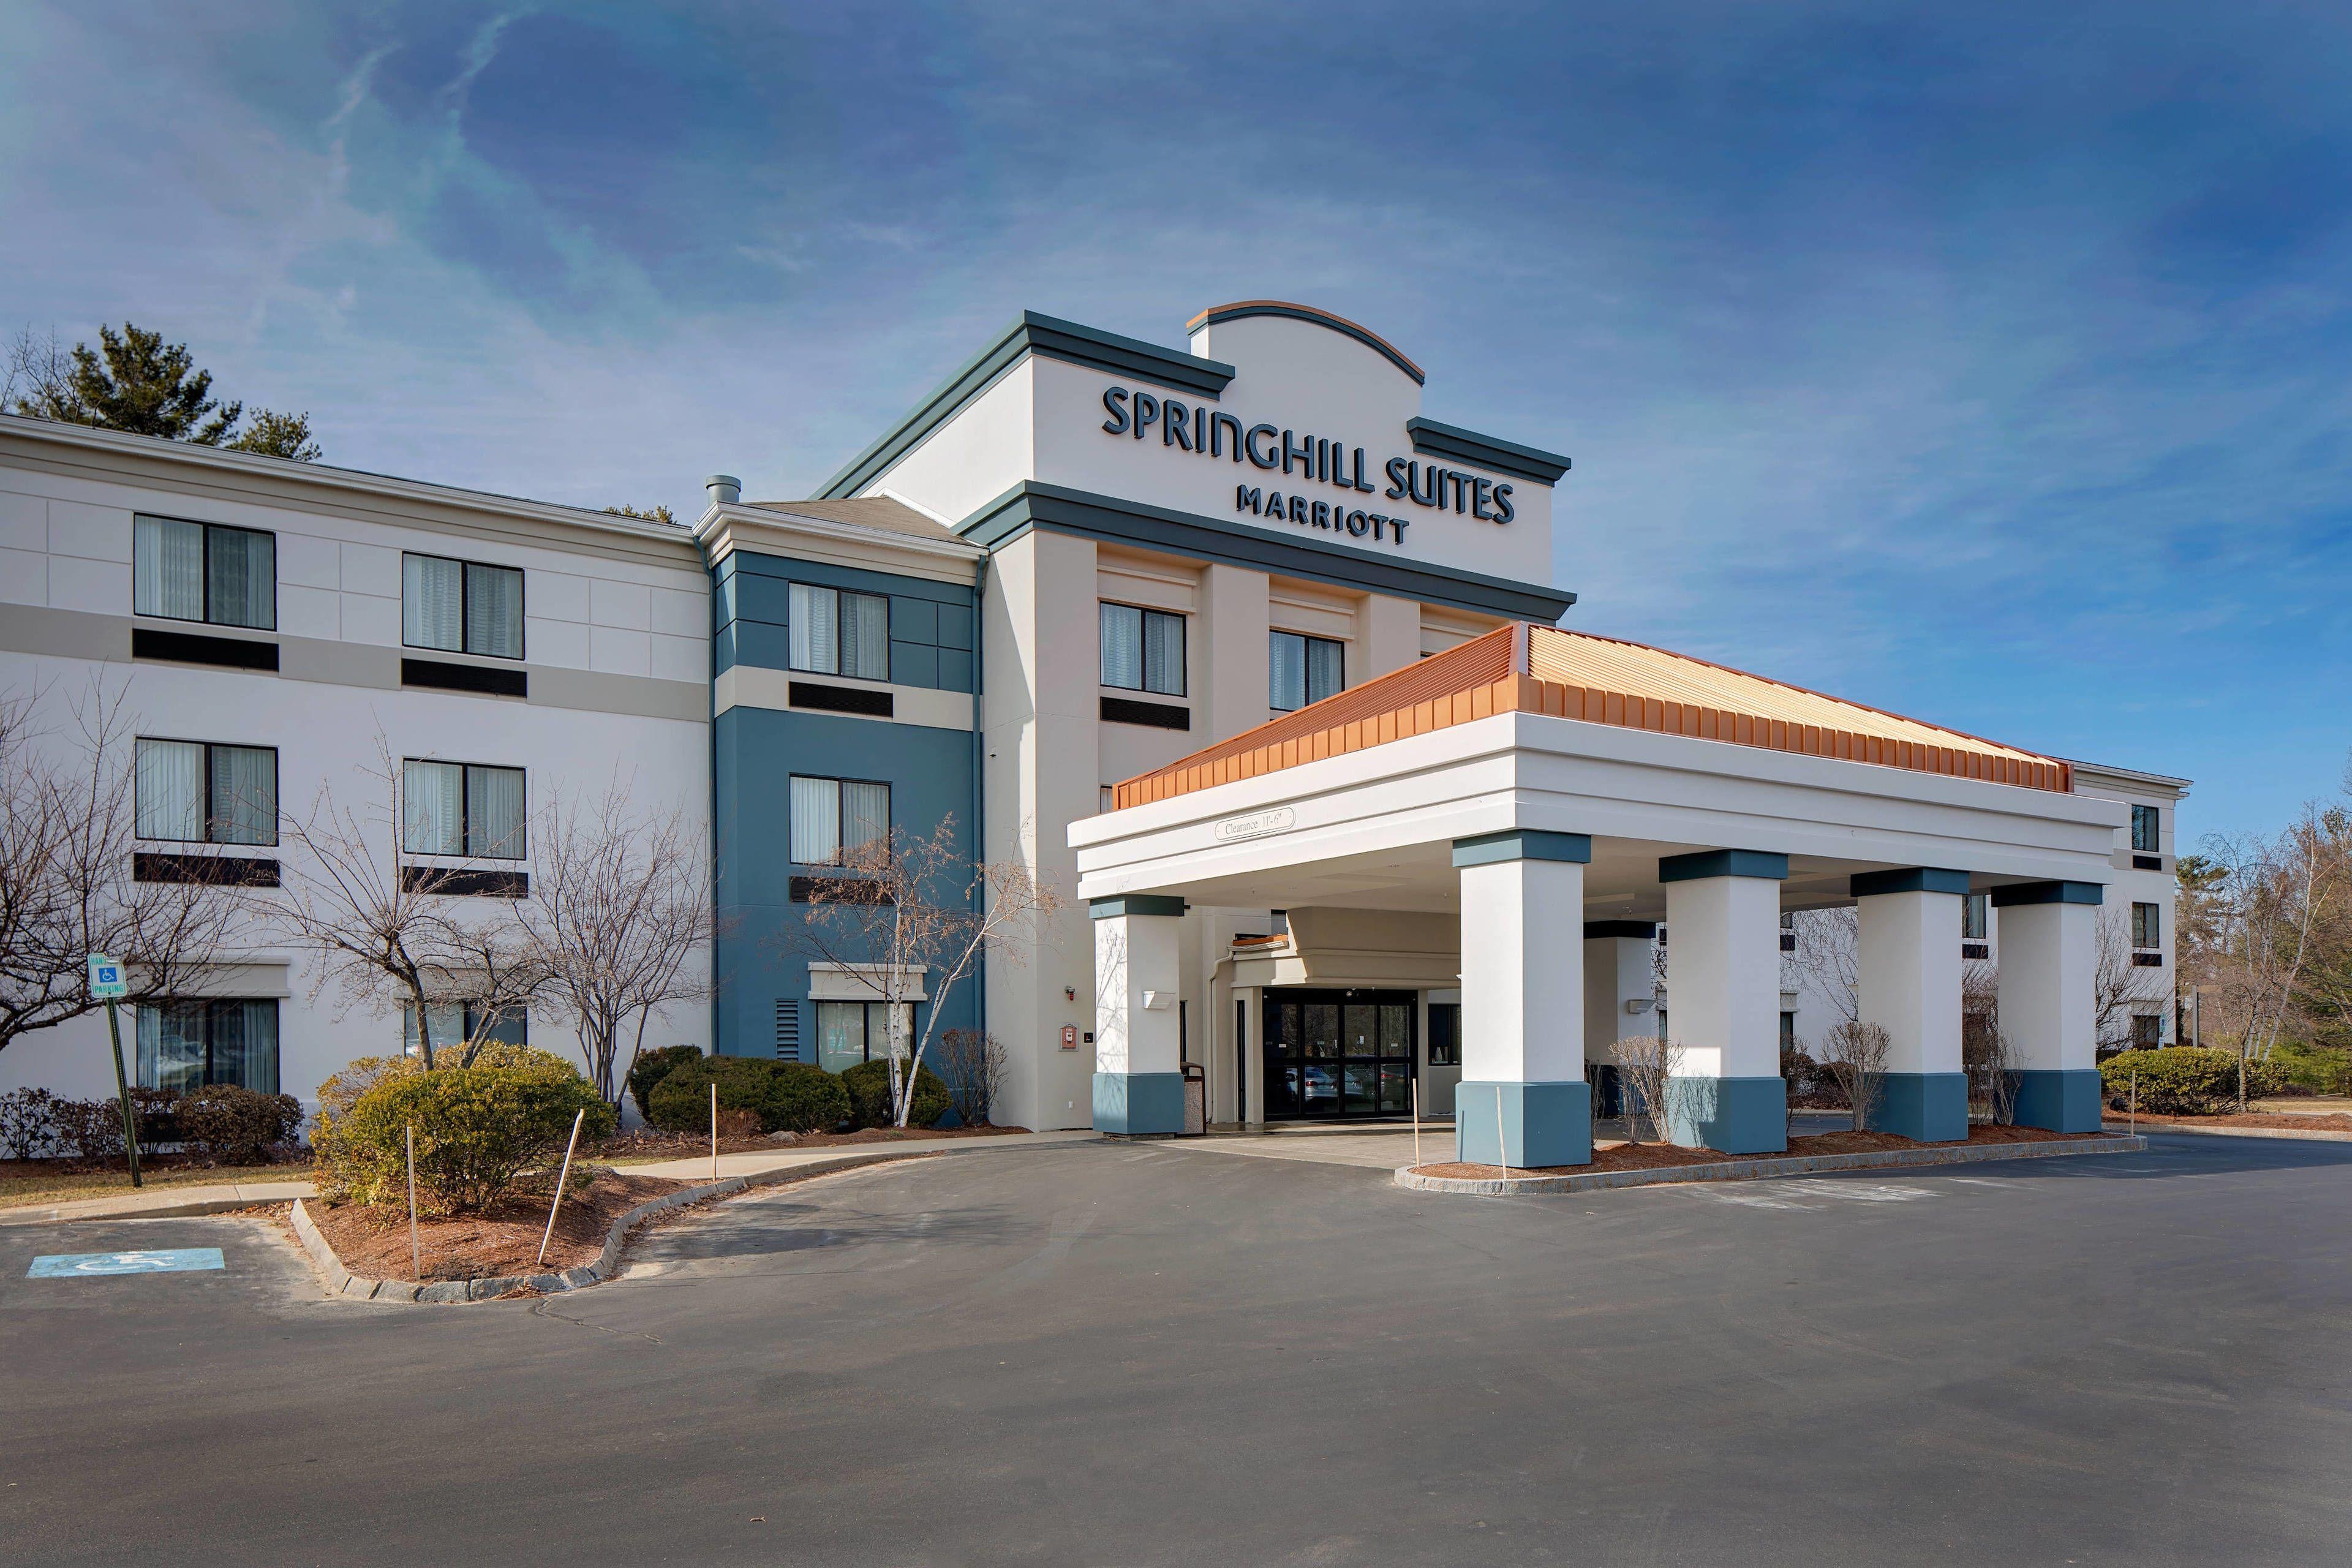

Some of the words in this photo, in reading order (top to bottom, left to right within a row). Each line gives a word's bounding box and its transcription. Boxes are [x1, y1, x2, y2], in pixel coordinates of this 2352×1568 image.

[1102, 386, 1376, 493] SPRINGHILL
[1384, 456, 1515, 524] SUITES
[1236, 484, 1409, 545] MARRIOTT
[1226, 821, 1258, 835] Clearance
[95, 984, 123, 993] PARKING
